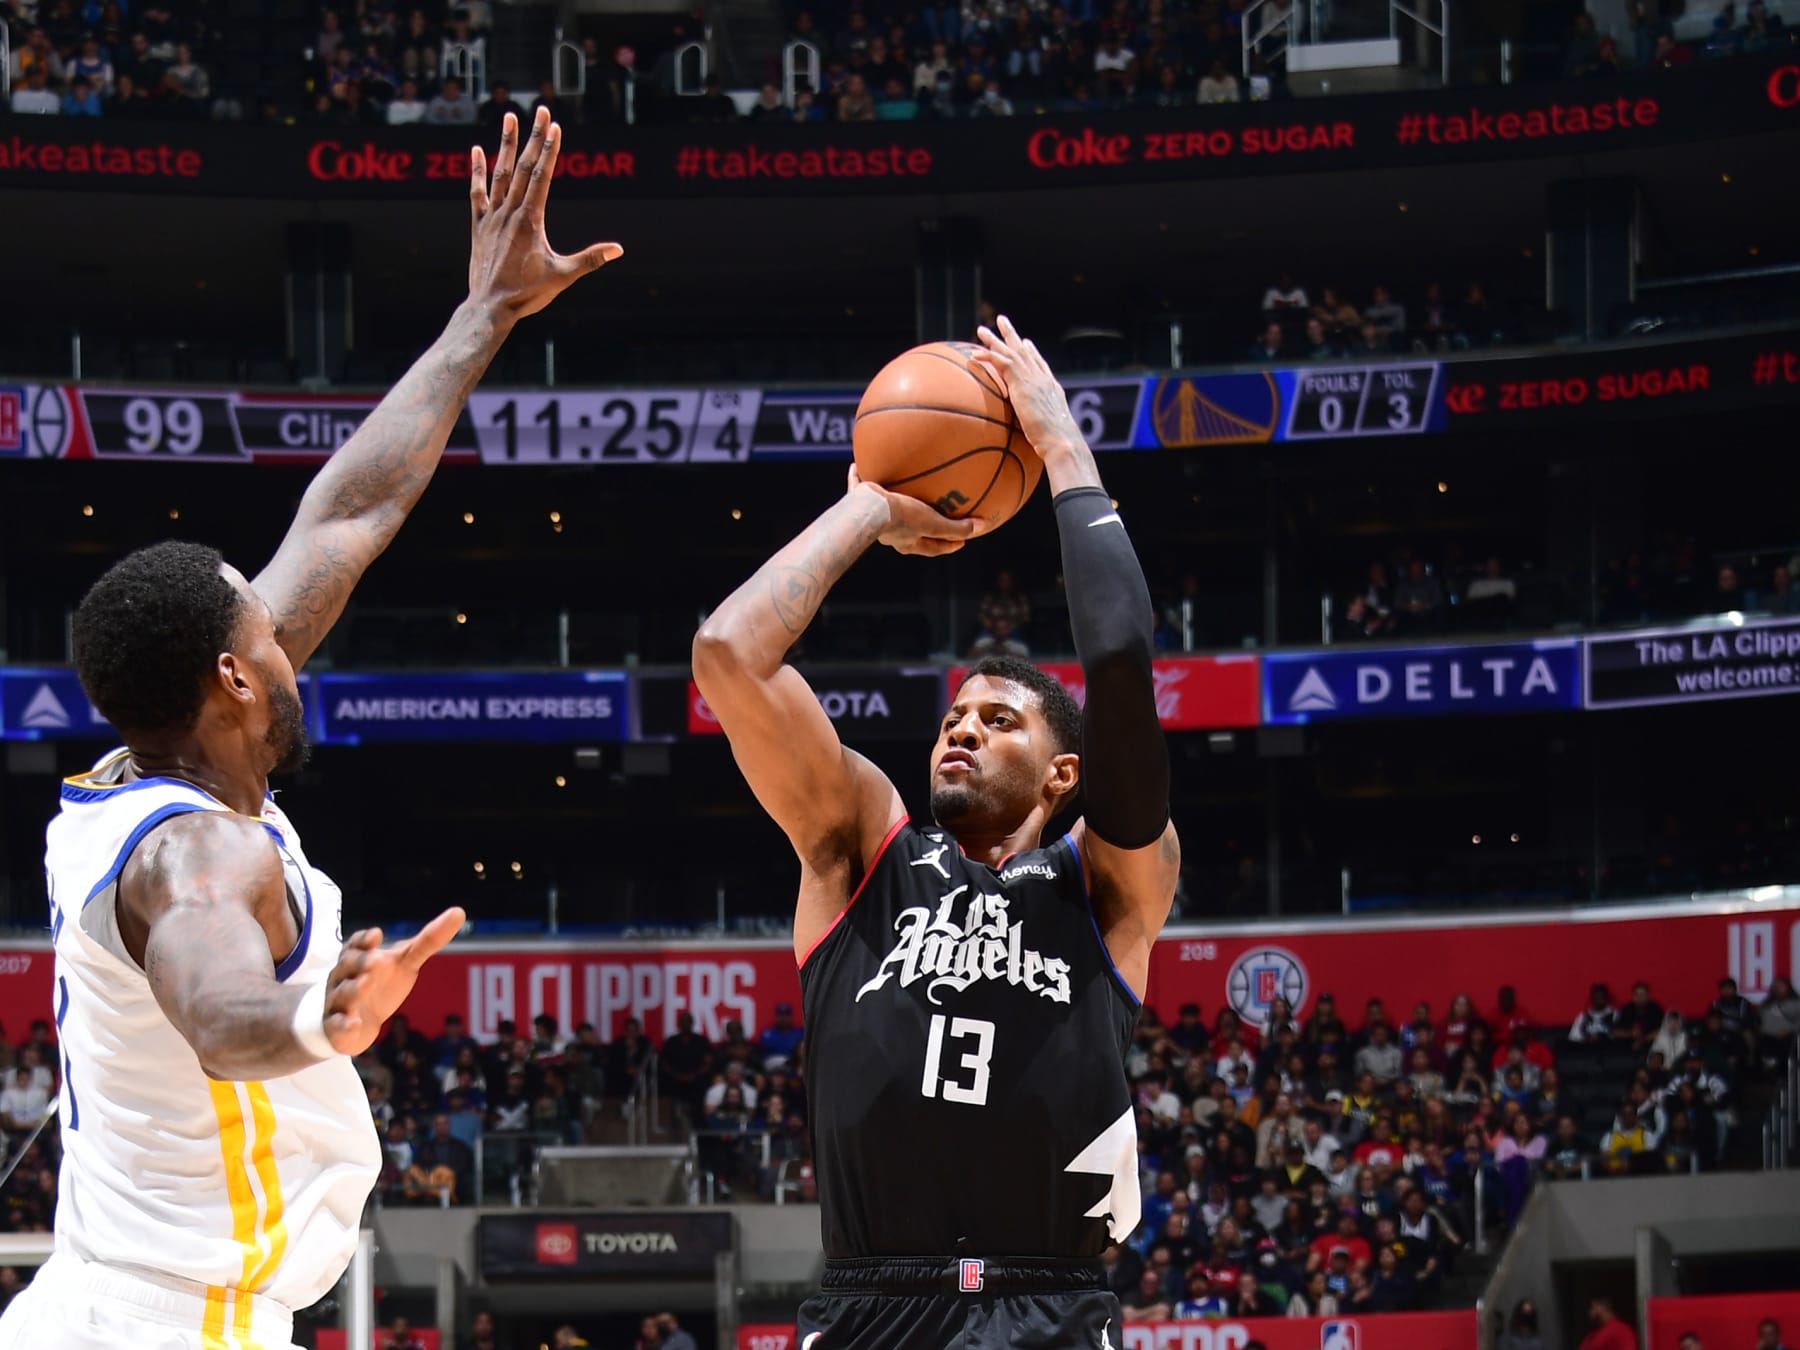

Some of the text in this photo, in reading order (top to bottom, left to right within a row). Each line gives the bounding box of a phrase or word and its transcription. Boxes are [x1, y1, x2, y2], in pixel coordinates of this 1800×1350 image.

[1396, 96, 1658, 145] #takeataste
[307, 140, 411, 180] Coke
[675, 143, 932, 178] #takeataste
[1027, 122, 1355, 168] Coke ZERO SUGAR
[1304, 374, 1360, 394] FOULS
[1383, 371, 1415, 389] TOL
[1498, 380, 1587, 409] ZERO
[1597, 364, 1711, 400] SUGAR
[124, 398, 203, 454] 99
[491, 398, 683, 461] 11:25
[789, 411, 853, 443] Wa
[1319, 396, 1343, 433] 0
[1387, 392, 1411, 430] 3
[714, 414, 742, 459] 4
[1635, 640, 1684, 665] The
[1692, 634, 1729, 660] LA
[1357, 657, 1559, 703] DELTA
[337, 696, 612, 721] AMERICAN EXPRESS
[924, 884, 1011, 941] Los
[855, 906, 1072, 1006] Angeles
[1179, 942, 1217, 962] 208
[529, 961, 756, 1044] CLIPPERS
[921, 1014, 996, 1106] 13
[585, 1232, 678, 1254] TOYOTA
